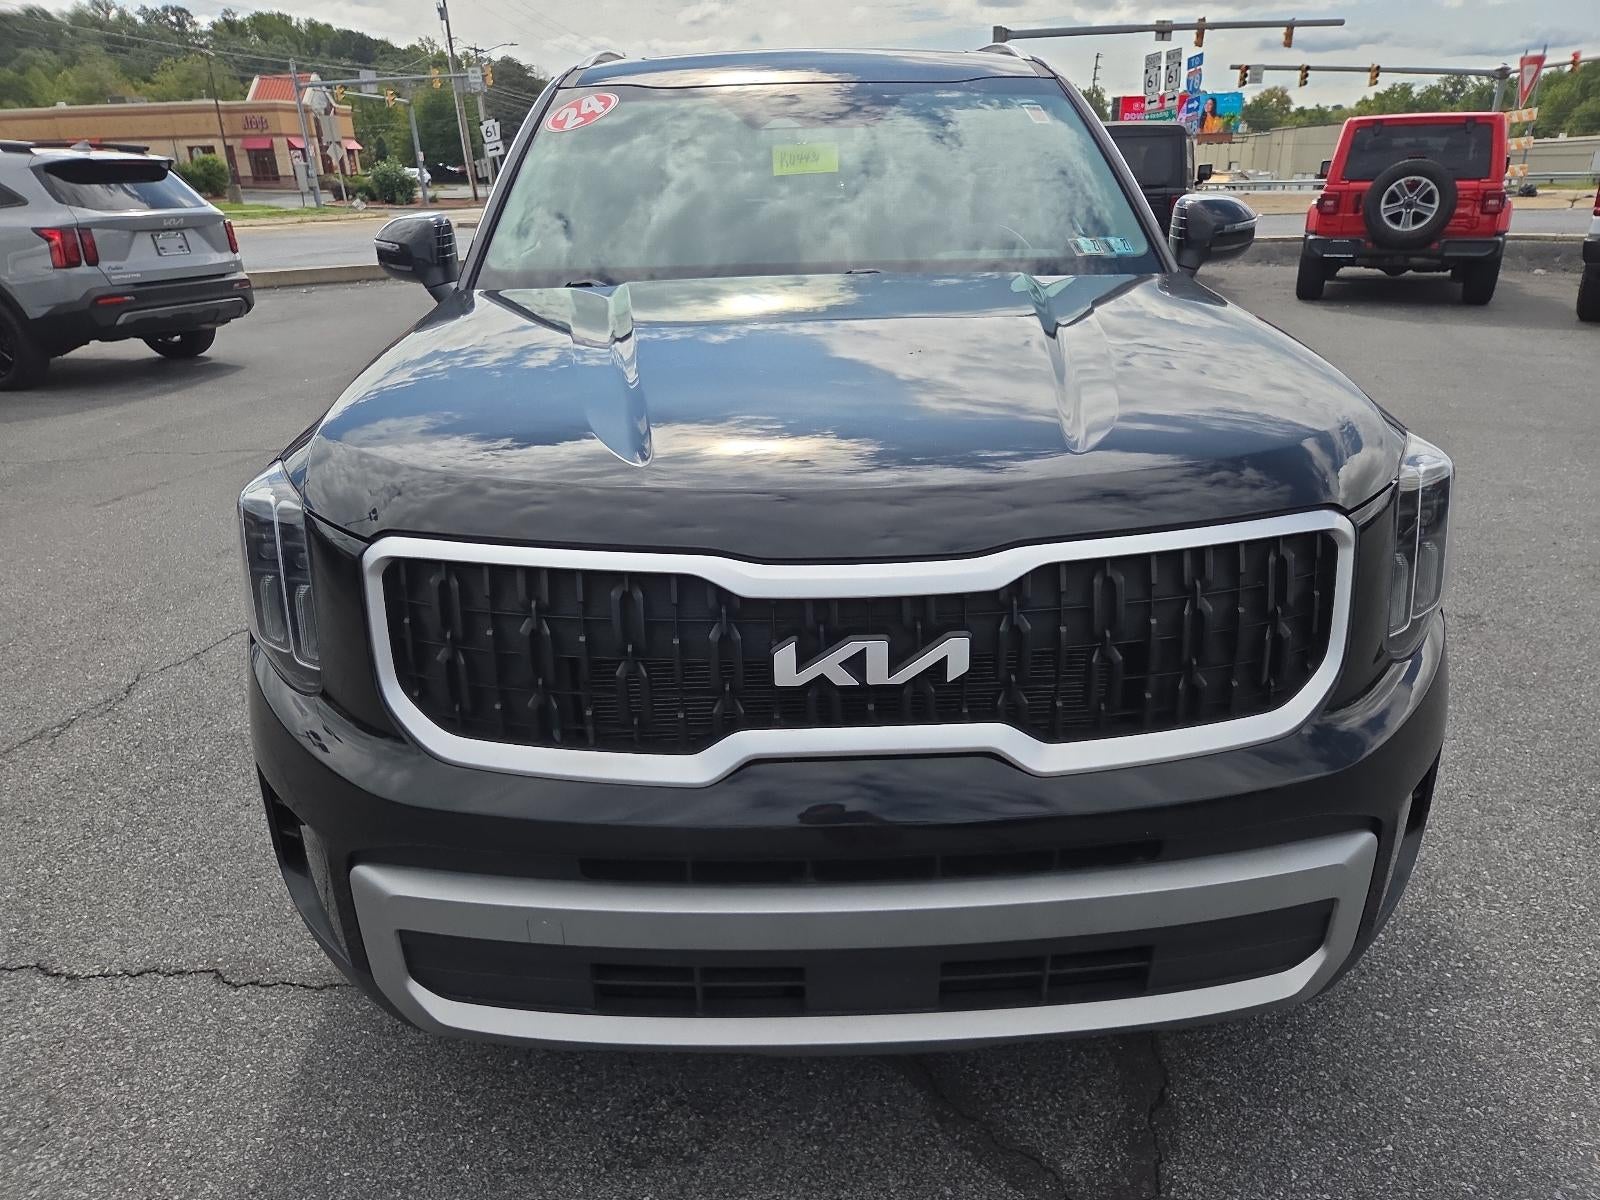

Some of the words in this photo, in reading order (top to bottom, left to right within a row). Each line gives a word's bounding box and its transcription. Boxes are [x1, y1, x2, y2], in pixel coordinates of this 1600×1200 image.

[1191, 56, 1200, 66] TO
[1147, 73, 1158, 88] 61
[1168, 68, 1178, 83] 61
[1188, 74, 1200, 93] 78
[557, 95, 605, 128] 24
[485, 124, 497, 138] 61
[773, 636, 970, 687] KIA
